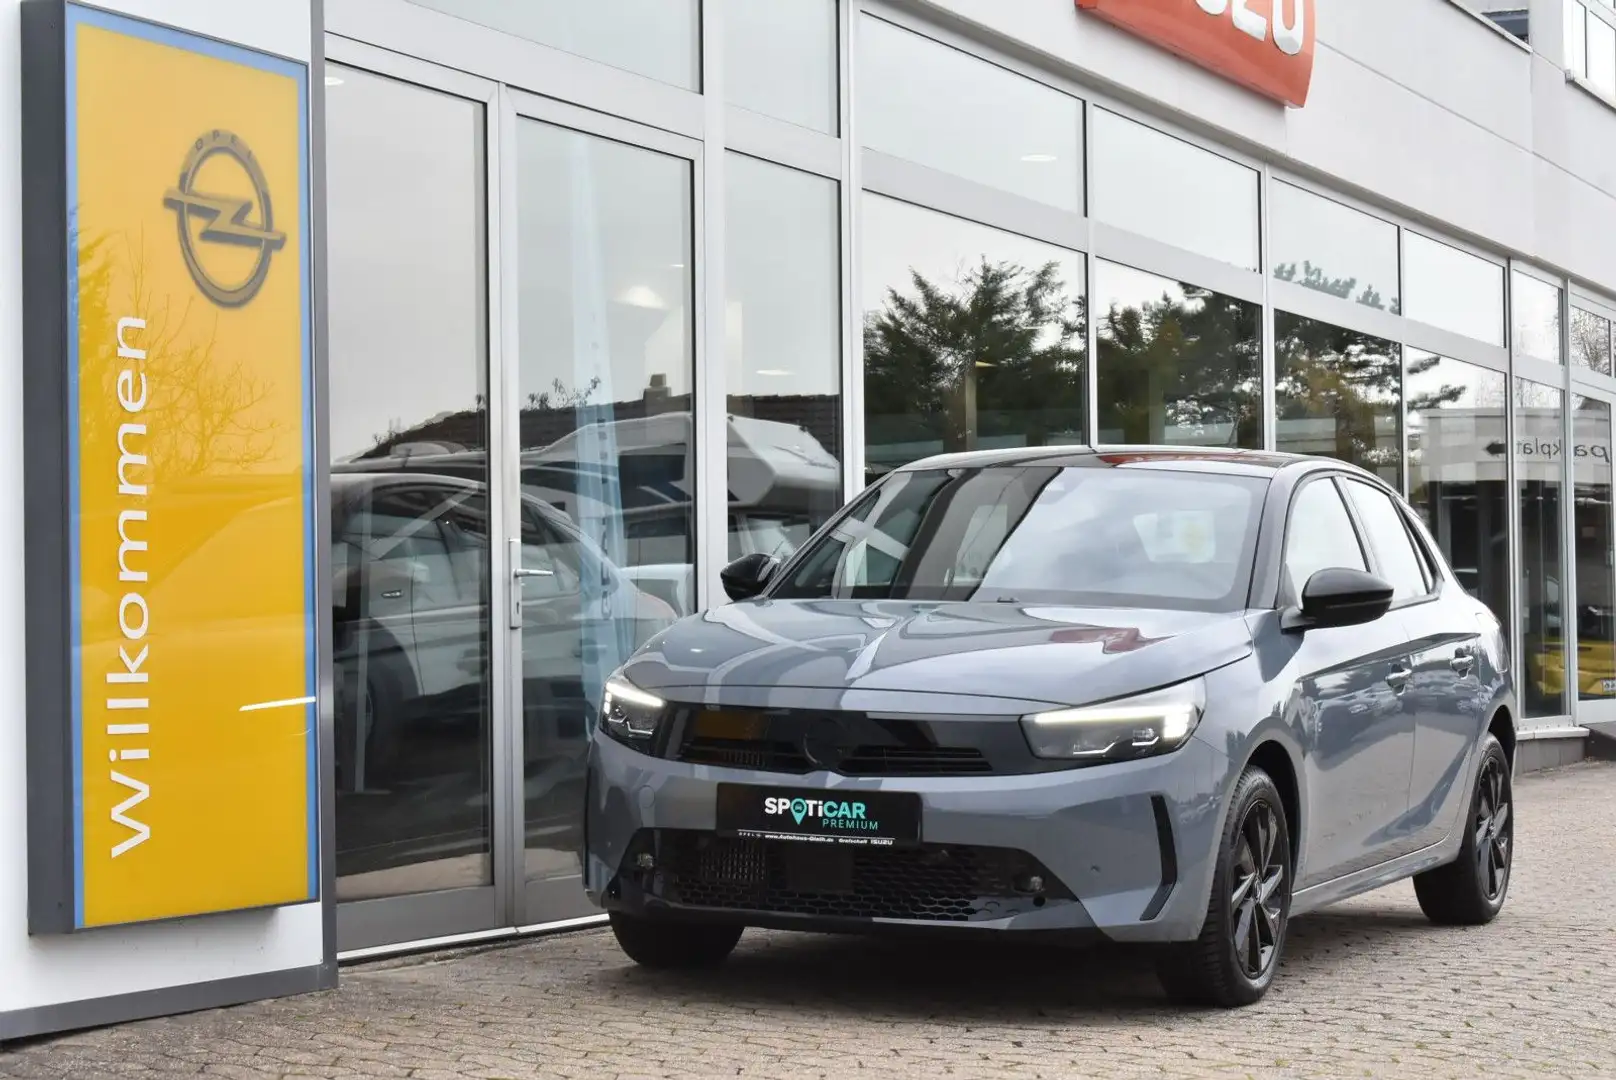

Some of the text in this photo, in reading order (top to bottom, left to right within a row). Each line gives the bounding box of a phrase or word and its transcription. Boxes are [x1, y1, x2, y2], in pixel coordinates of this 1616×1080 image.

[106, 315, 150, 858] Willkommen
[822, 818, 879, 831] PREMIUM
[870, 838, 893, 846] ISUZU
